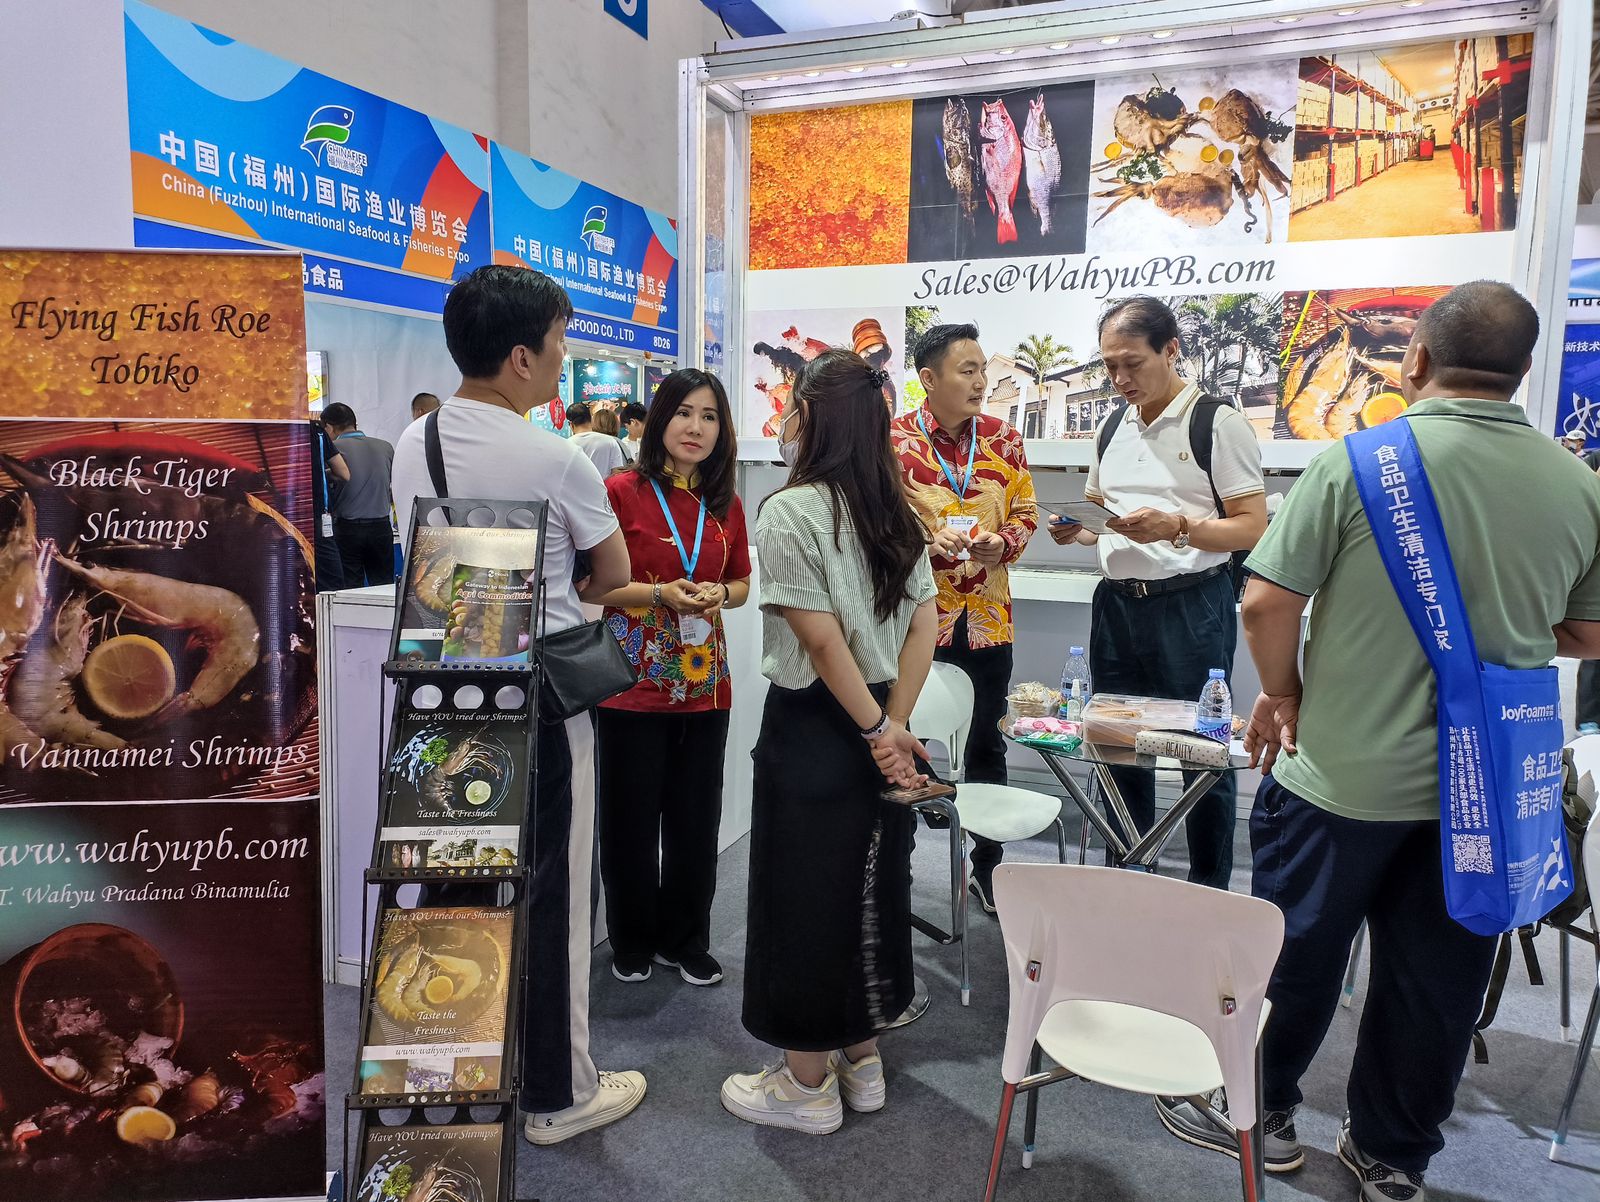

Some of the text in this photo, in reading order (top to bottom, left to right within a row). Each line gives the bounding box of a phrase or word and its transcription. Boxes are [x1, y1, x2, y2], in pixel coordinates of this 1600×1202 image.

[159, 130, 468, 244] 中国（福州）国际渔业博览会
[162, 173, 470, 264] China (Fuzhou) International Seafood & Fisheries Expo
[914, 255, 1276, 299] Sales@WahyuPB.com
[11, 297, 271, 341] Flying Fish Roe
[619, 328, 635, 342] LTD
[653, 336, 671, 350] 8D26
[91, 353, 200, 393] Tobiko
[50, 455, 236, 498] Black Tiger
[80, 508, 209, 549] Shrimps
[465, 582, 490, 590] Gateway
[456, 588, 476, 601] Agri
[407, 713, 430, 721] Have
[431, 713, 455, 721] YOU
[490, 712, 527, 723] Shrimps?
[1501, 704, 1546, 721] JoyFoam
[11, 735, 309, 776] Vannamei Shrimps
[1165, 741, 1194, 760] BEAUTY
[417, 809, 498, 819] Taste the Freshness
[418, 827, 492, 838] sales@wahyupb.com
[22, 883, 96, 909] Wahyu
[101, 882, 185, 902] Pradana
[190, 879, 291, 900] Binamulia
[384, 910, 510, 922] Have YOU tried our Shrimps?
[417, 1010, 457, 1020] Taste the
[414, 1026, 457, 1036] Freshness
[368, 1129, 499, 1143] Have YOU tried our Shrimps?
